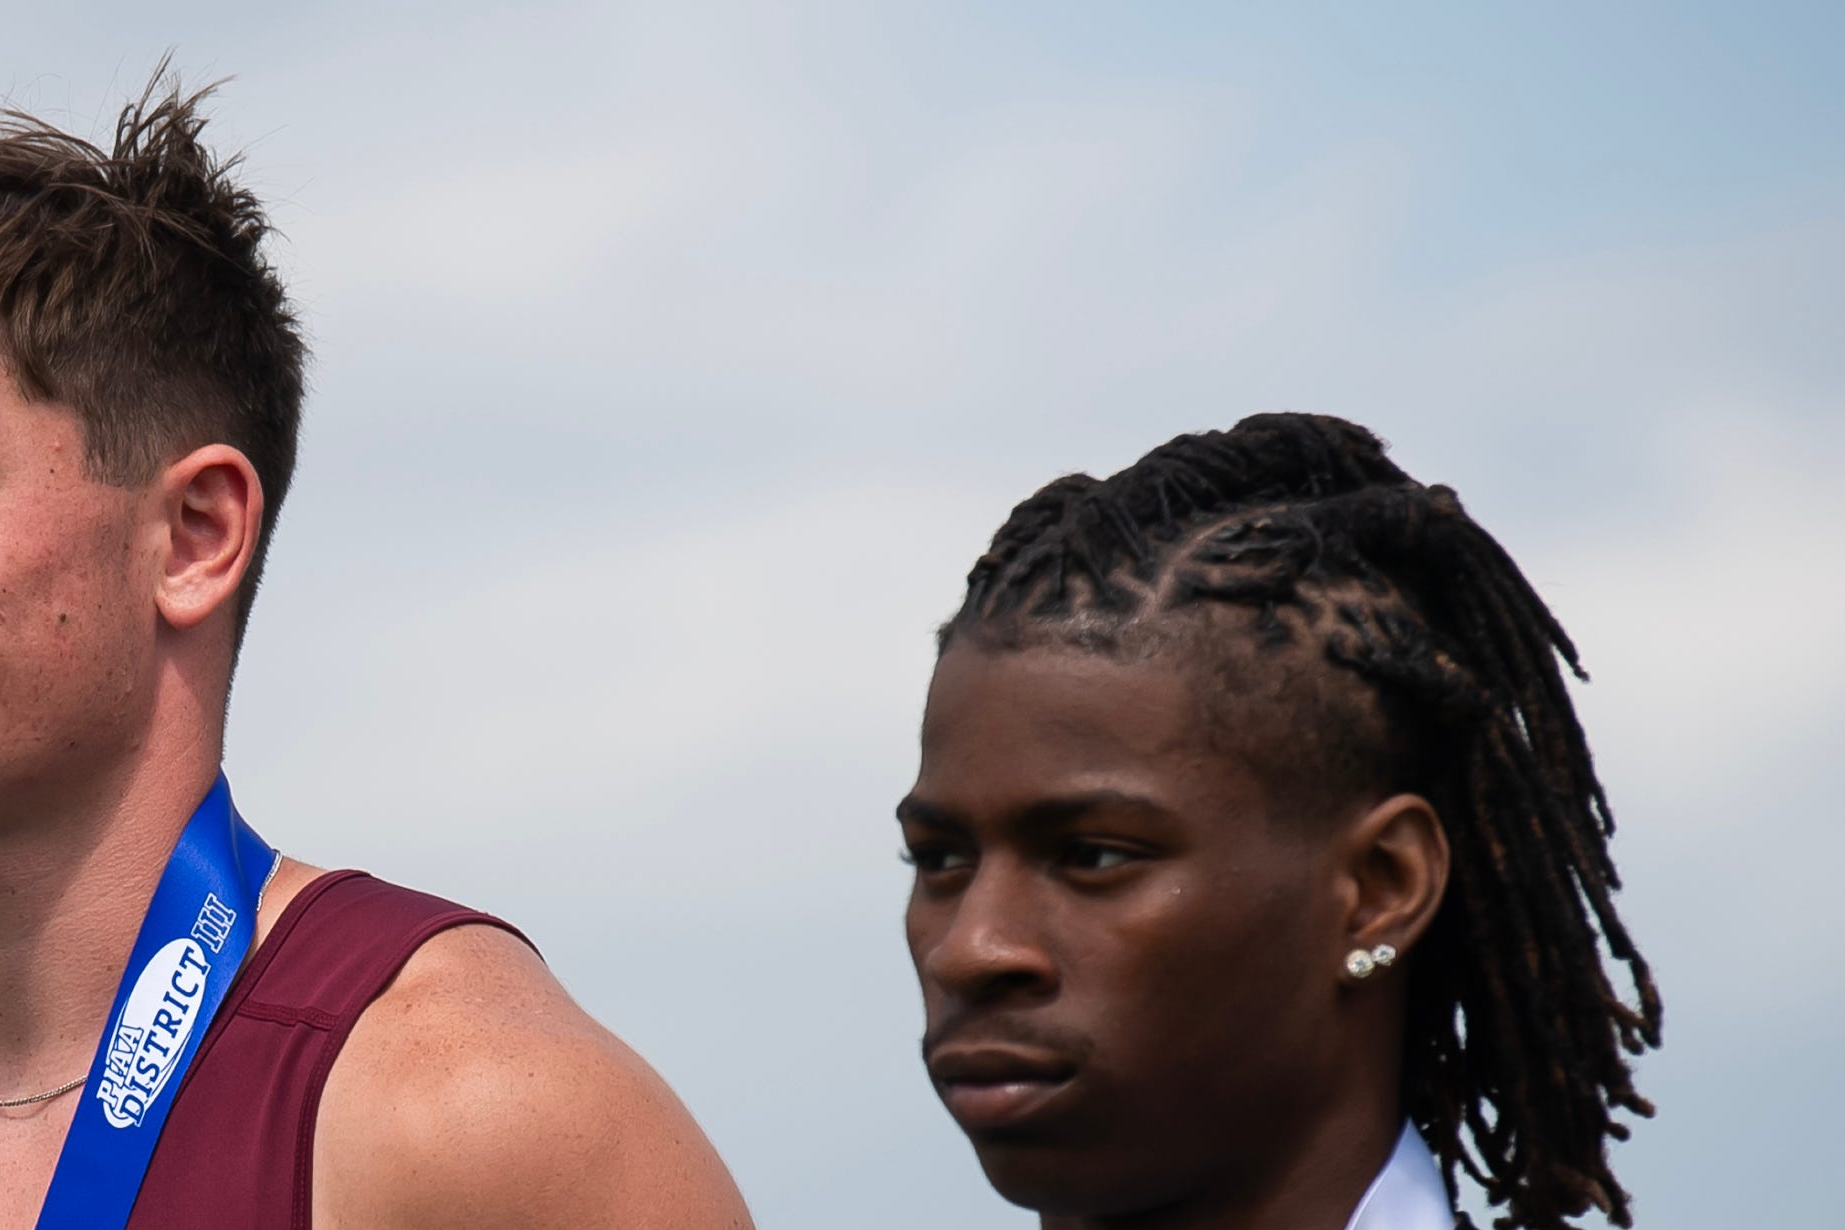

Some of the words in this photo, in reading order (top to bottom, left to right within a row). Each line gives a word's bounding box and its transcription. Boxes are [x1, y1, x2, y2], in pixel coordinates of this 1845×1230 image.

[95, 1023, 145, 1110] PIAA
[119, 945, 211, 1127] DISTRICT
[191, 891, 237, 954] III
